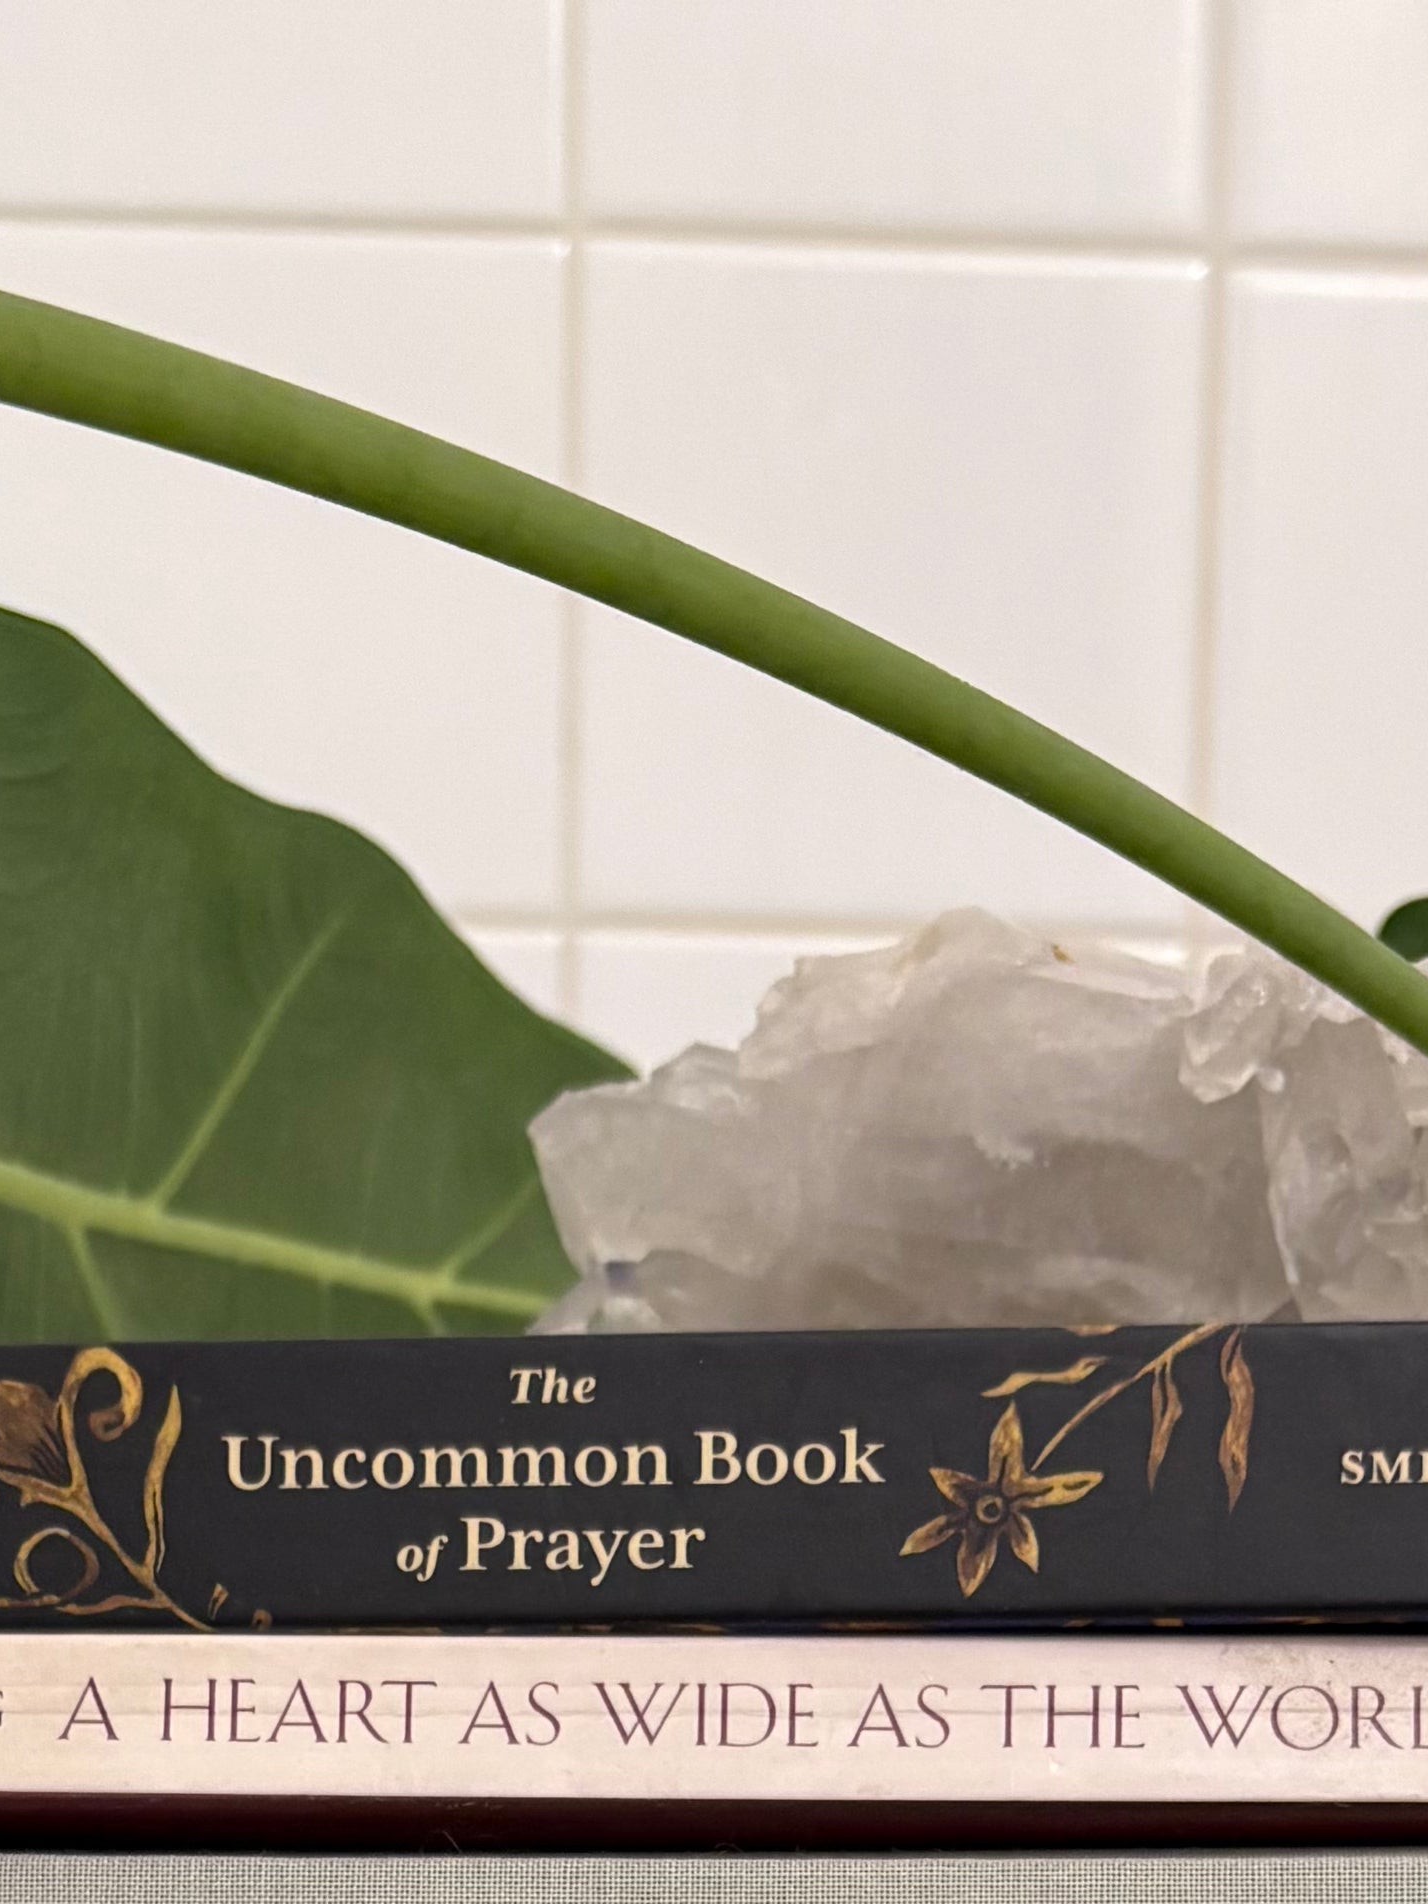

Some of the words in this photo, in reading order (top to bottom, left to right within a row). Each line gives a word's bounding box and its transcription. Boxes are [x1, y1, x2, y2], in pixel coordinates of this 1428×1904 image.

[510, 1367, 596, 1403] The
[222, 1435, 672, 1490] Uncommon
[694, 1427, 885, 1485] Book
[397, 1534, 448, 1581] of
[460, 1517, 705, 1580] Prayer
[59, 1677, 118, 1740] A
[162, 1678, 437, 1743] HEART
[459, 1681, 561, 1746] AS
[593, 1682, 818, 1747] WIDE
[848, 1683, 950, 1748] AS
[980, 1684, 1145, 1748] THE
